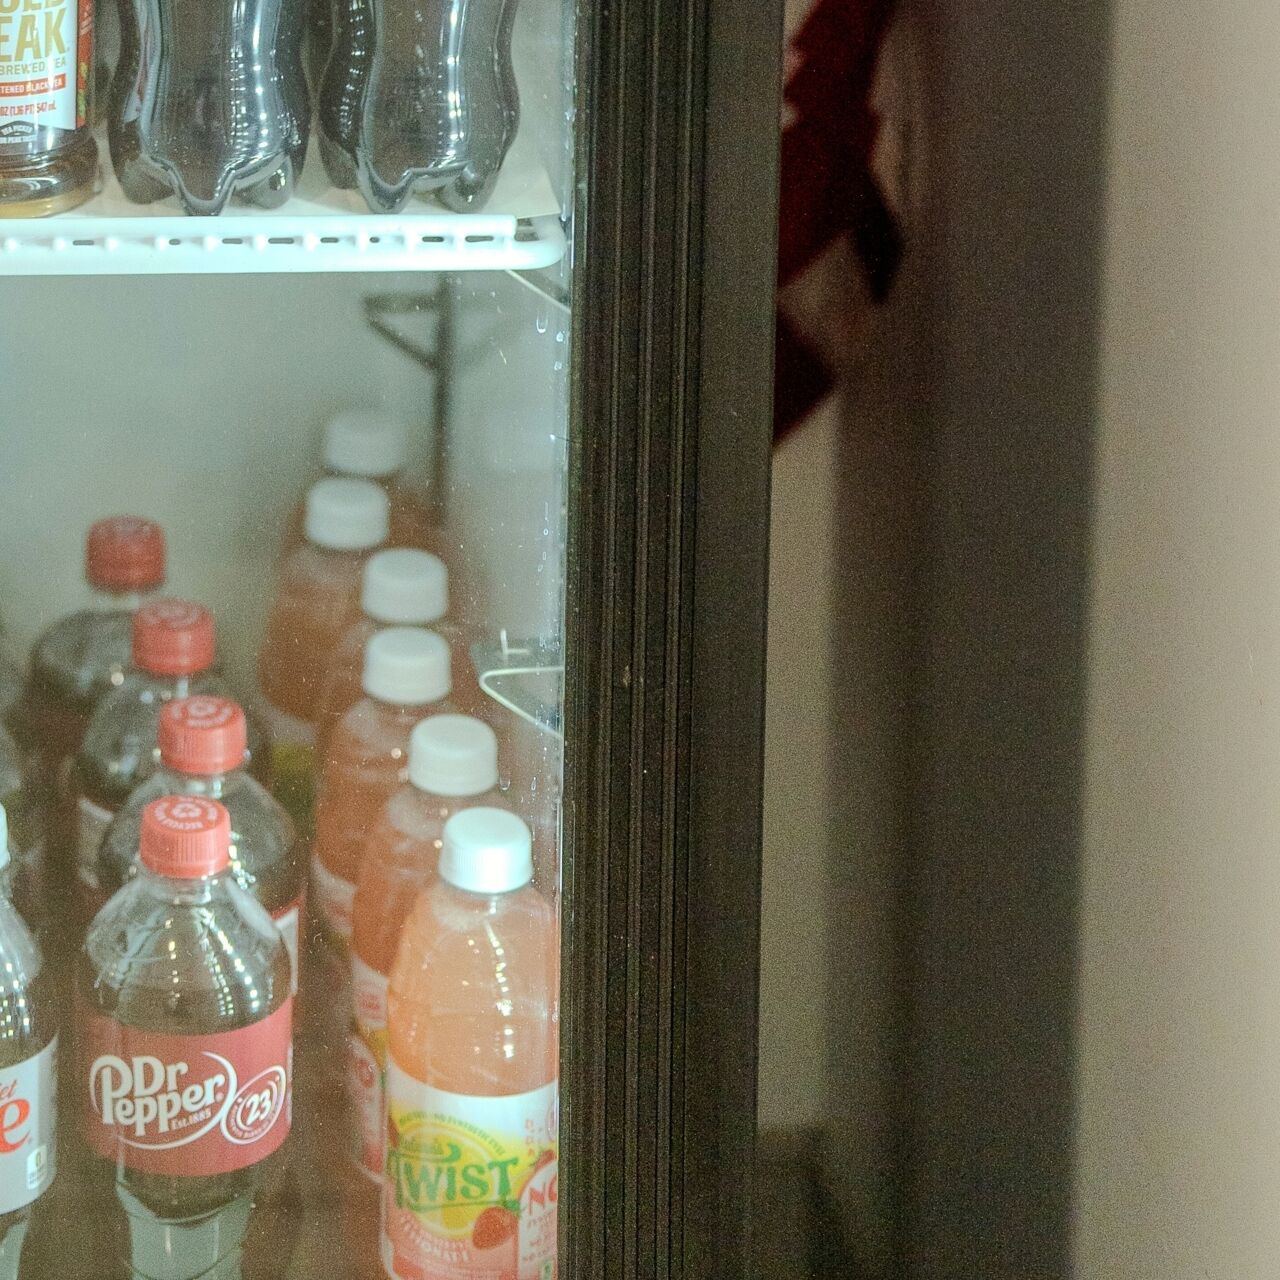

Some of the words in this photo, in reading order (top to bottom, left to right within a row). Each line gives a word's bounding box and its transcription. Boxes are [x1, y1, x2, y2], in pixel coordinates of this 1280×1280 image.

[89, 1055, 226, 1137] Pepper
[132, 1055, 189, 1097] Dr
[245, 1088, 272, 1126] 23
[387, 1151, 520, 1210] TWIST
